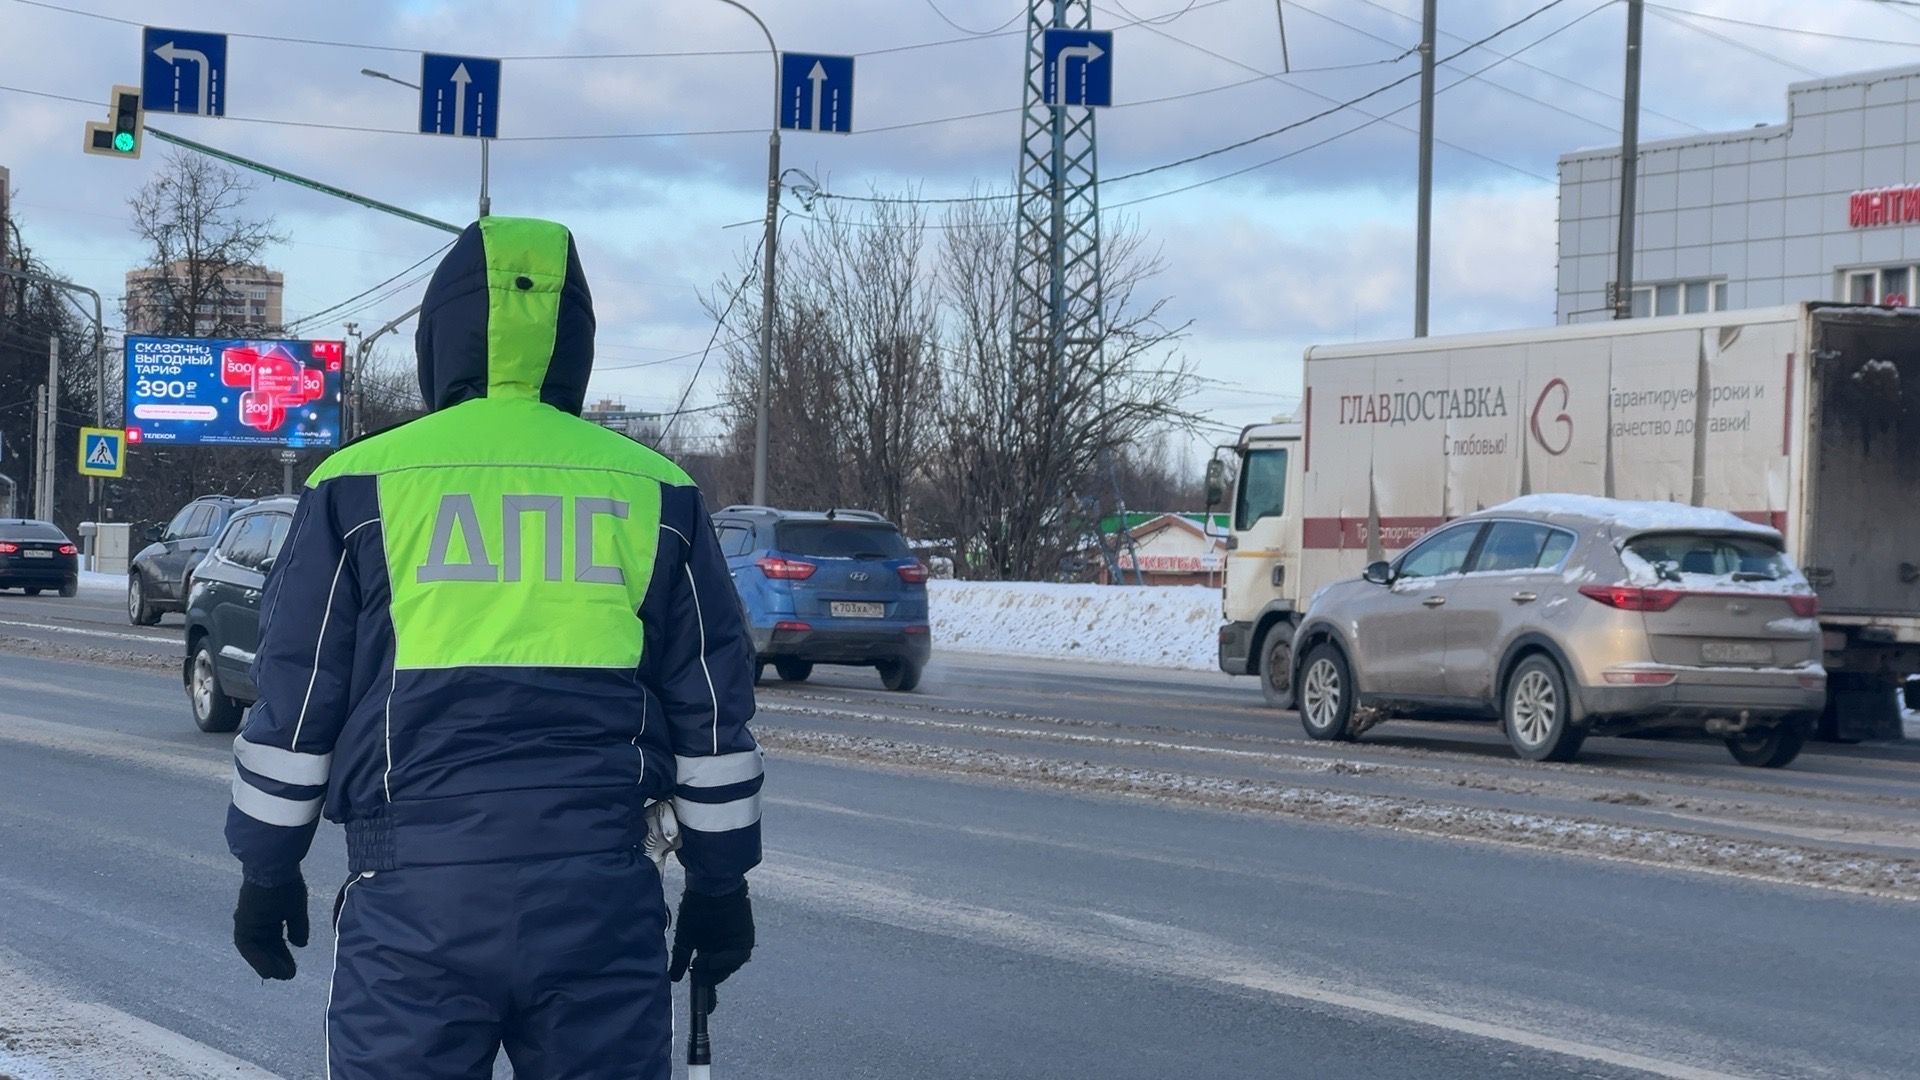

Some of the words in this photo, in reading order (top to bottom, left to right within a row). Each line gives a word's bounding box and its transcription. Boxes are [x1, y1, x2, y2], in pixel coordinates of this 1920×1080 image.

[134, 354, 213, 366] ВЫГОДНЫЙ
[134, 364, 182, 375] ТАРИФ
[227, 362, 252, 373] 500
[303, 379, 320, 390] 30
[245, 403, 269, 415] 200
[1339, 386, 1508, 427] ГЛАВДОСТАВКА
[143, 432, 176, 441] ТЕЛЕКОМ
[1453, 432, 1508, 456] любовью!
[417, 494, 630, 585] ДПС
